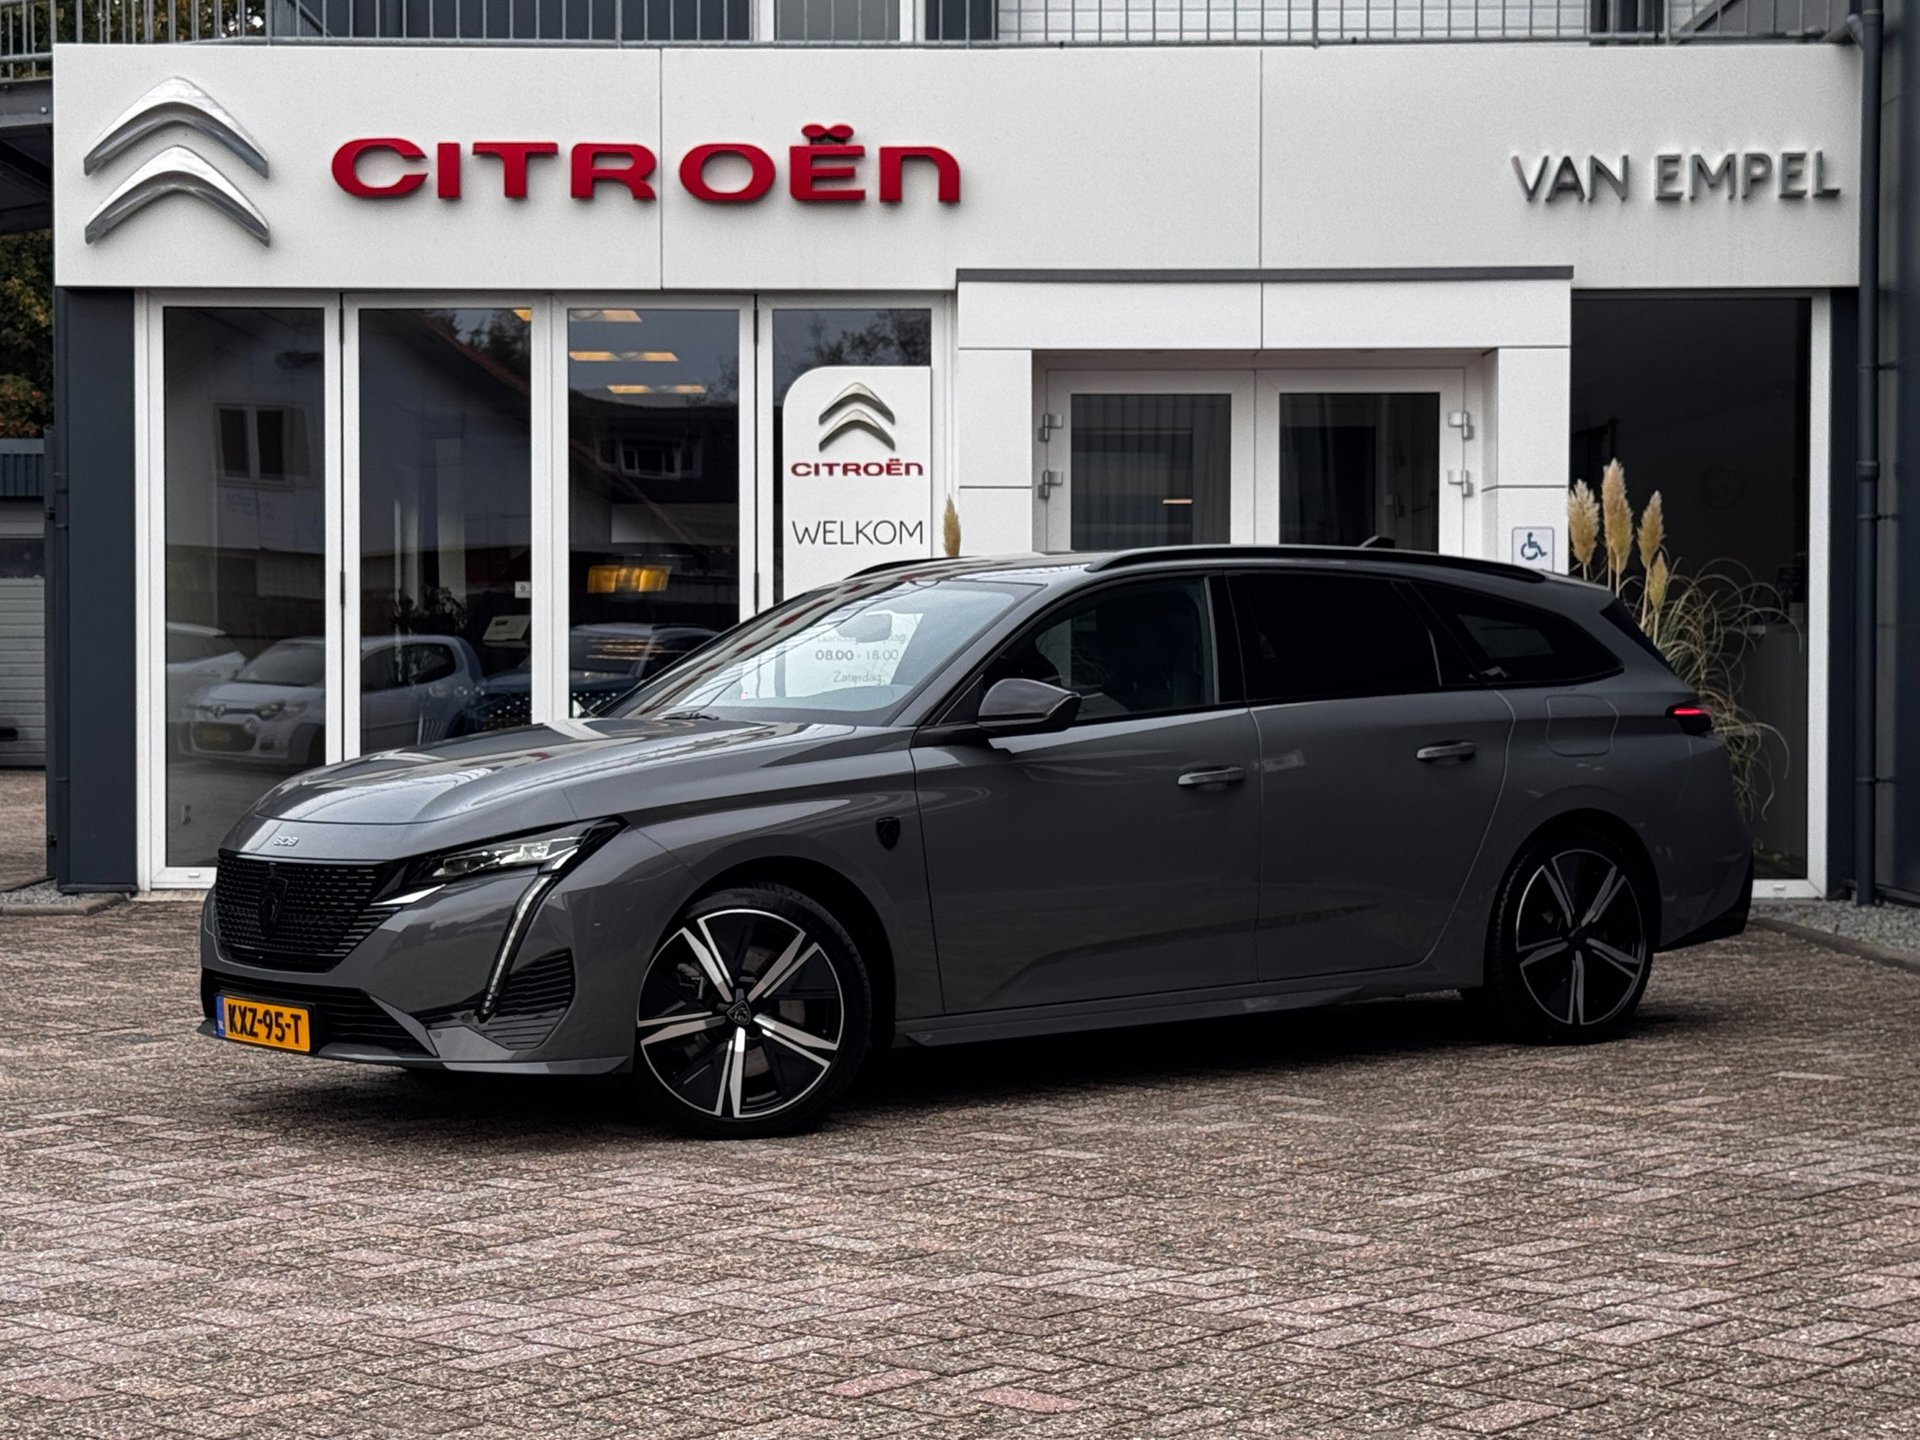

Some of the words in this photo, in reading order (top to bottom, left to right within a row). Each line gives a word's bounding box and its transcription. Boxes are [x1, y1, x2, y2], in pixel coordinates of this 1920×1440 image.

[1510, 153, 1629, 202] VAN
[1653, 149, 1841, 202] EMPEL
[792, 520, 923, 545] WELKOM
[228, 1003, 302, 1045] KXZ-95-T
